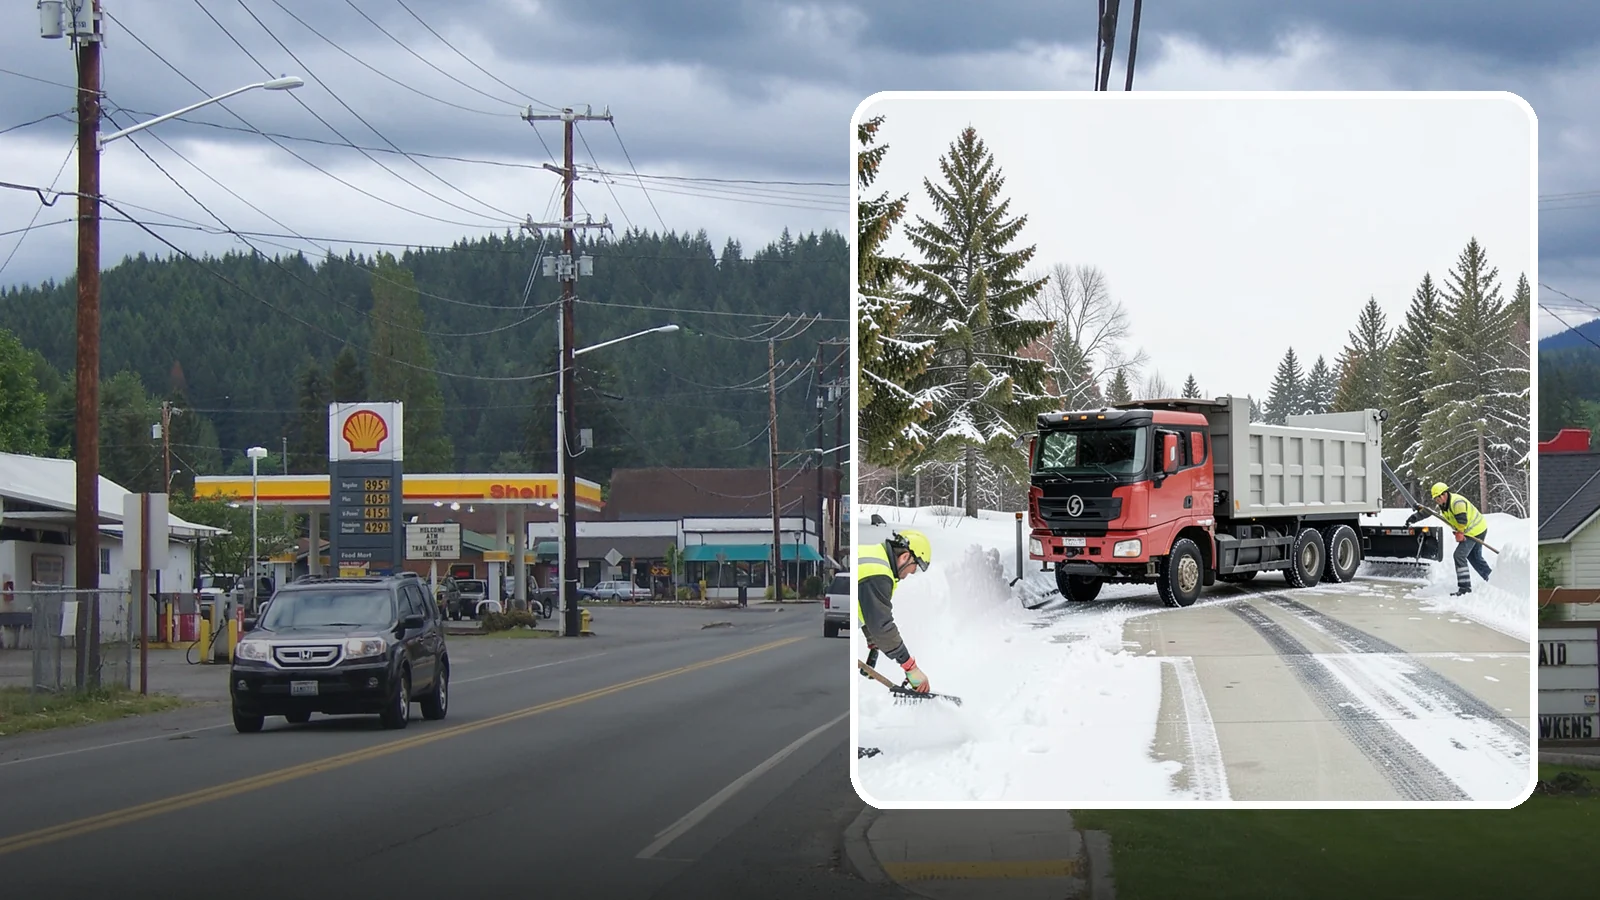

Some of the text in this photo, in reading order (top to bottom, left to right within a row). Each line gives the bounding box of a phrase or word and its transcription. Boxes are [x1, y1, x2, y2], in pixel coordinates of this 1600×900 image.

[366, 480, 383, 490] 395
[490, 484, 547, 499] Shell
[366, 494, 383, 504] 405
[366, 508, 383, 518] 415
[366, 522, 383, 533] 429
